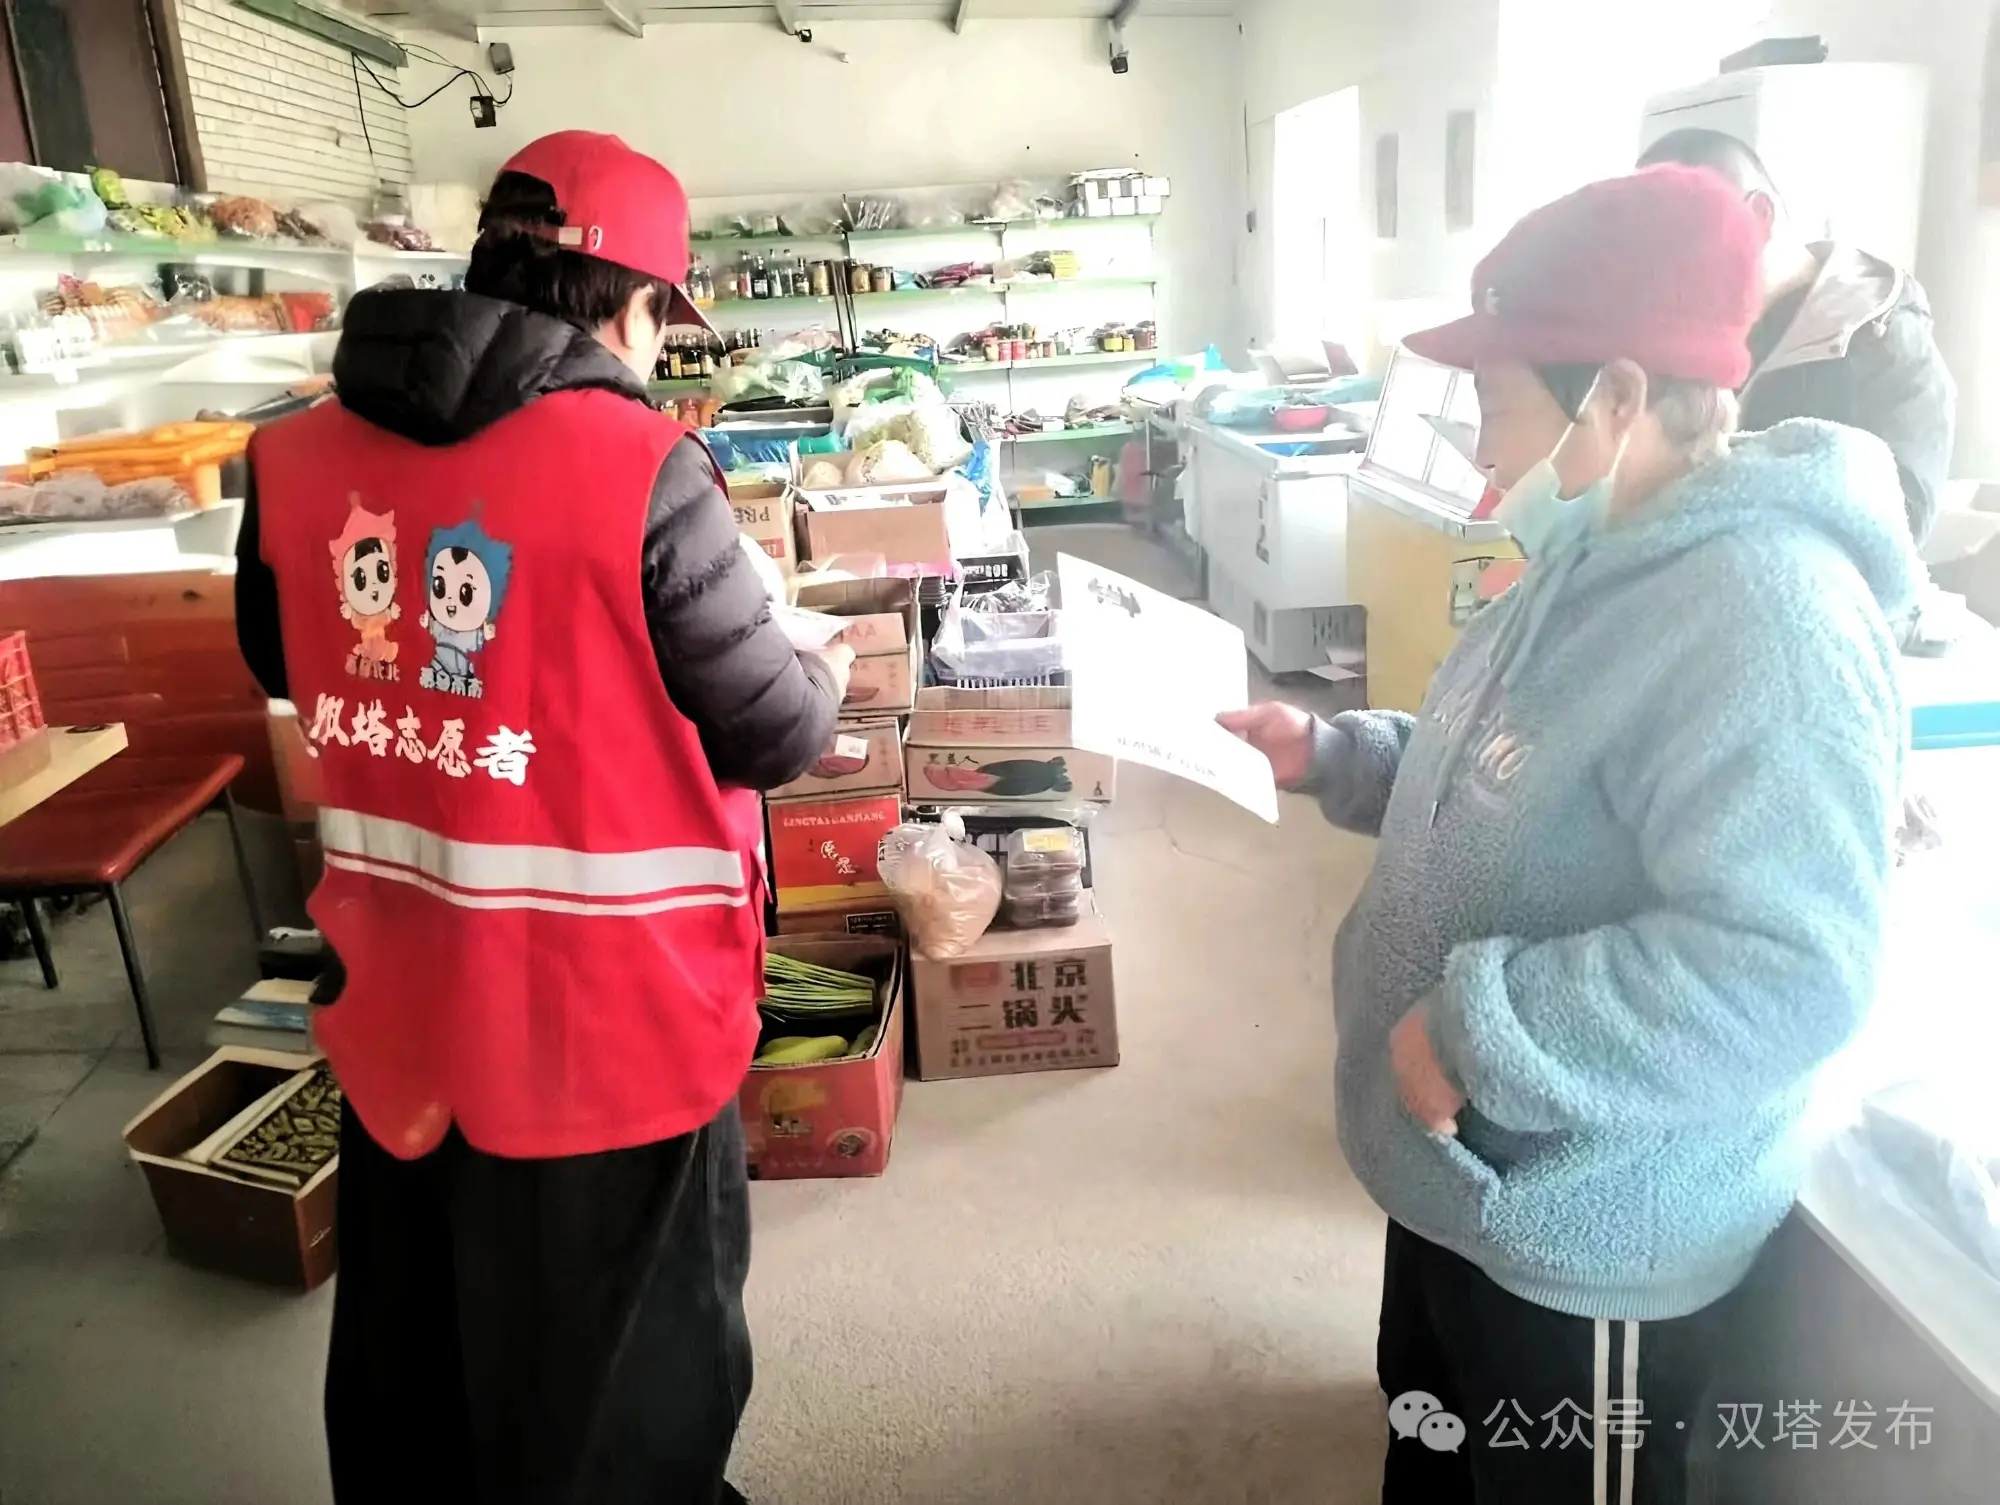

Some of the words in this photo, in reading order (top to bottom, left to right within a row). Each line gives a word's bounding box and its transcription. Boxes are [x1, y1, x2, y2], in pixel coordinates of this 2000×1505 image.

[1010, 958, 1089, 992] 北京
[957, 994, 1090, 1031] 二锅头
